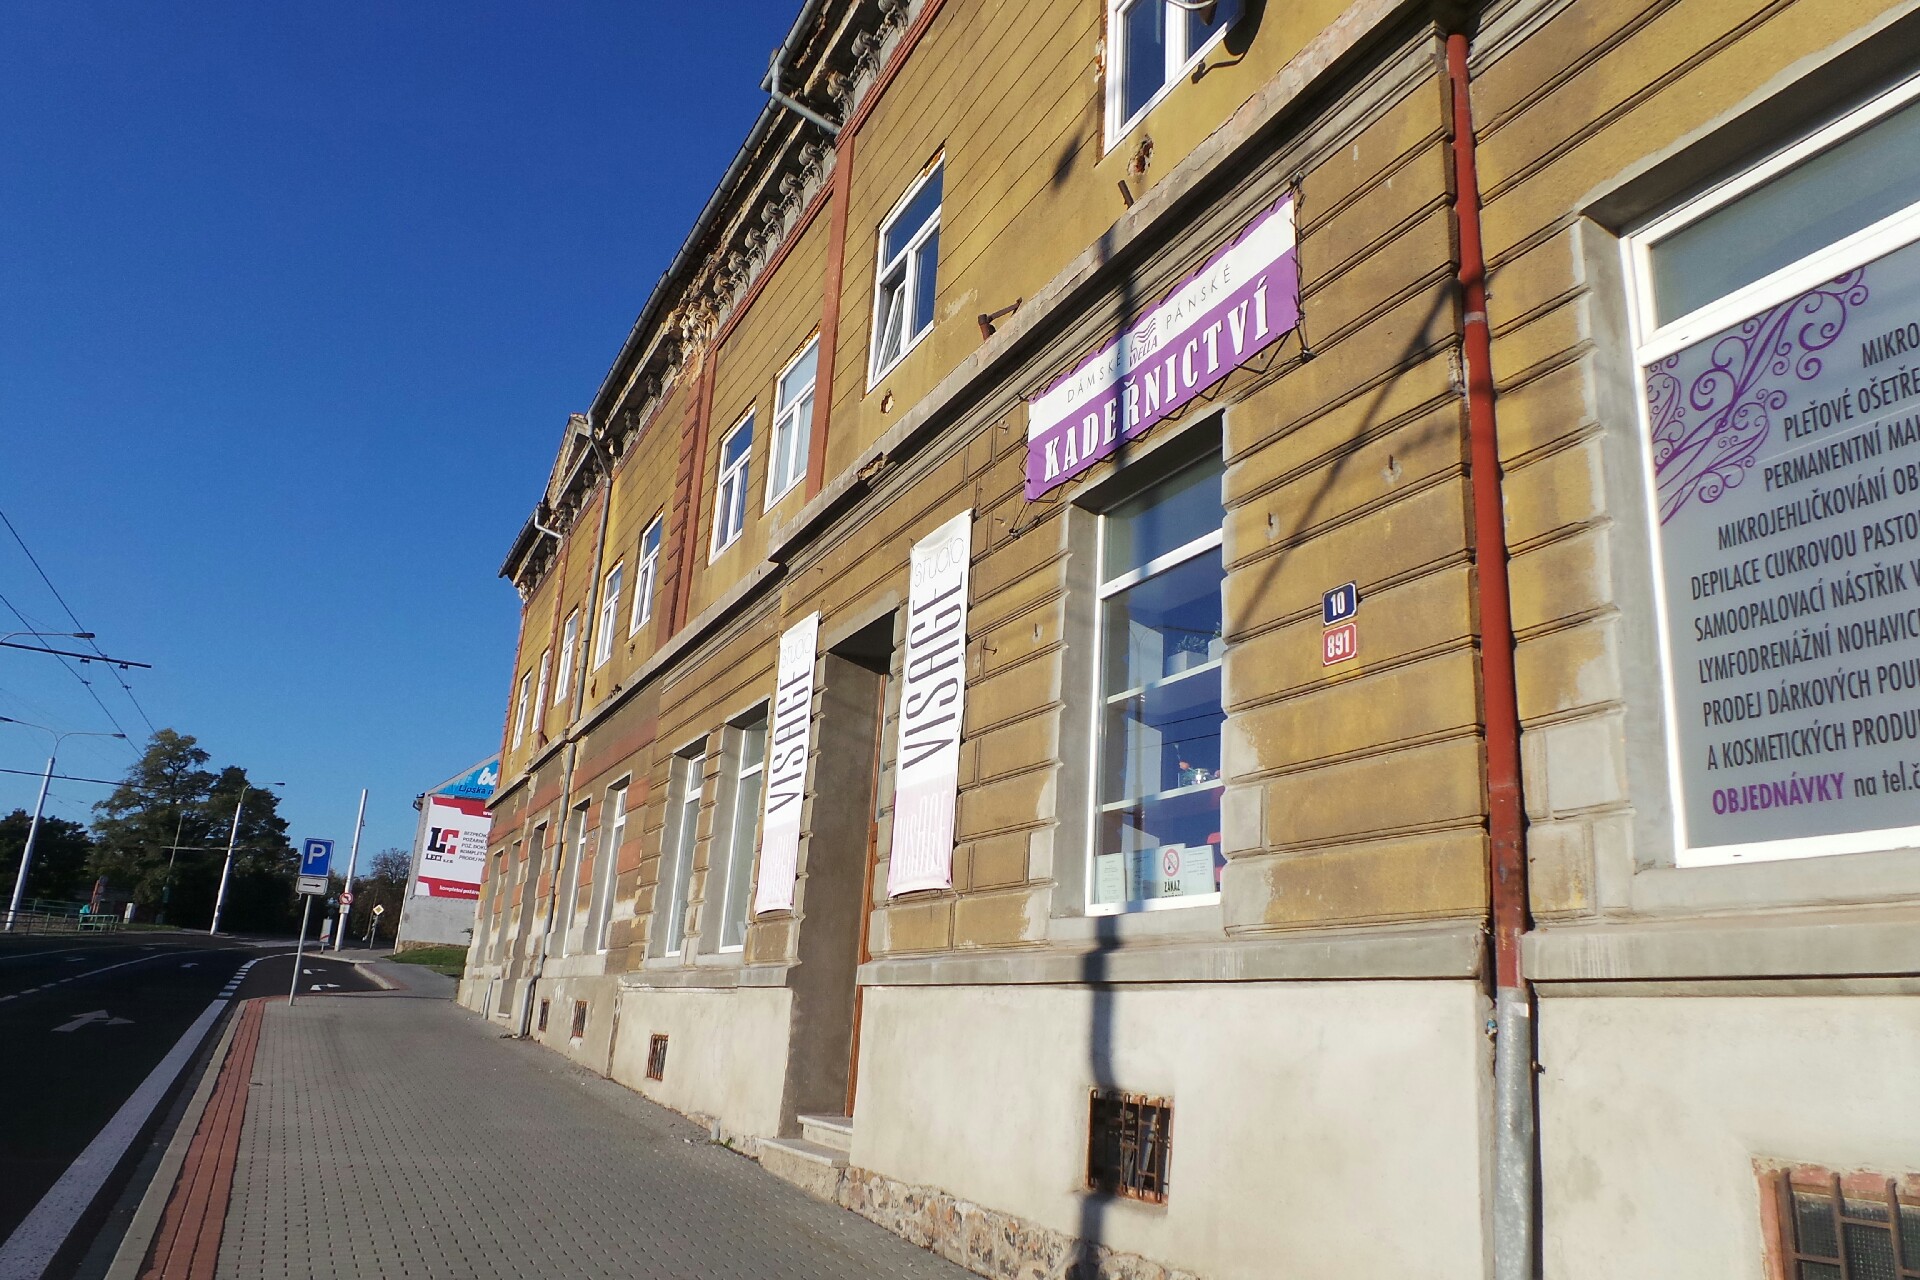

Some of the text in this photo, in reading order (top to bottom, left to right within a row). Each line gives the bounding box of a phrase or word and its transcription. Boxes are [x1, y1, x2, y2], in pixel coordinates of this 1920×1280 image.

[1067, 264, 1231, 403] DÁMSKÉ PÁNSKÉ
[1129, 335, 1158, 368] WELLA
[1044, 275, 1269, 483] KADEŘNICTVÍ
[1784, 388, 1854, 442] PLEŤOVÉ
[1764, 421, 1882, 492] PERMANENTNÍ
[1718, 461, 1920, 551] MIKROJEHLIČKOVÁNÍ OB
[1691, 510, 1920, 600] DEPILACE CUKROVOU PASTO
[1330, 591, 1346, 617] 10
[1694, 578, 1825, 642] SAMOOPALOVACÍ
[1830, 562, 1908, 608] NÁSTŘIK
[902, 570, 964, 771] VISAGE
[1327, 629, 1350, 658] 891
[1698, 608, 1920, 684] LYMFODRENÁŽNÍ NOHAVIC
[1703, 691, 1761, 727] PRODEJ
[1768, 667, 1871, 715] DÁRKOVÝCH
[767, 659, 812, 814] VISAGE
[1707, 708, 1920, 771] A KOSMETICKÝCH PRODU
[1712, 771, 1845, 815] OBJEDNÁVKY
[1854, 776, 1878, 797] na
[307, 843, 327, 865] P
[1164, 878, 1181, 893] ZÁKAZ
